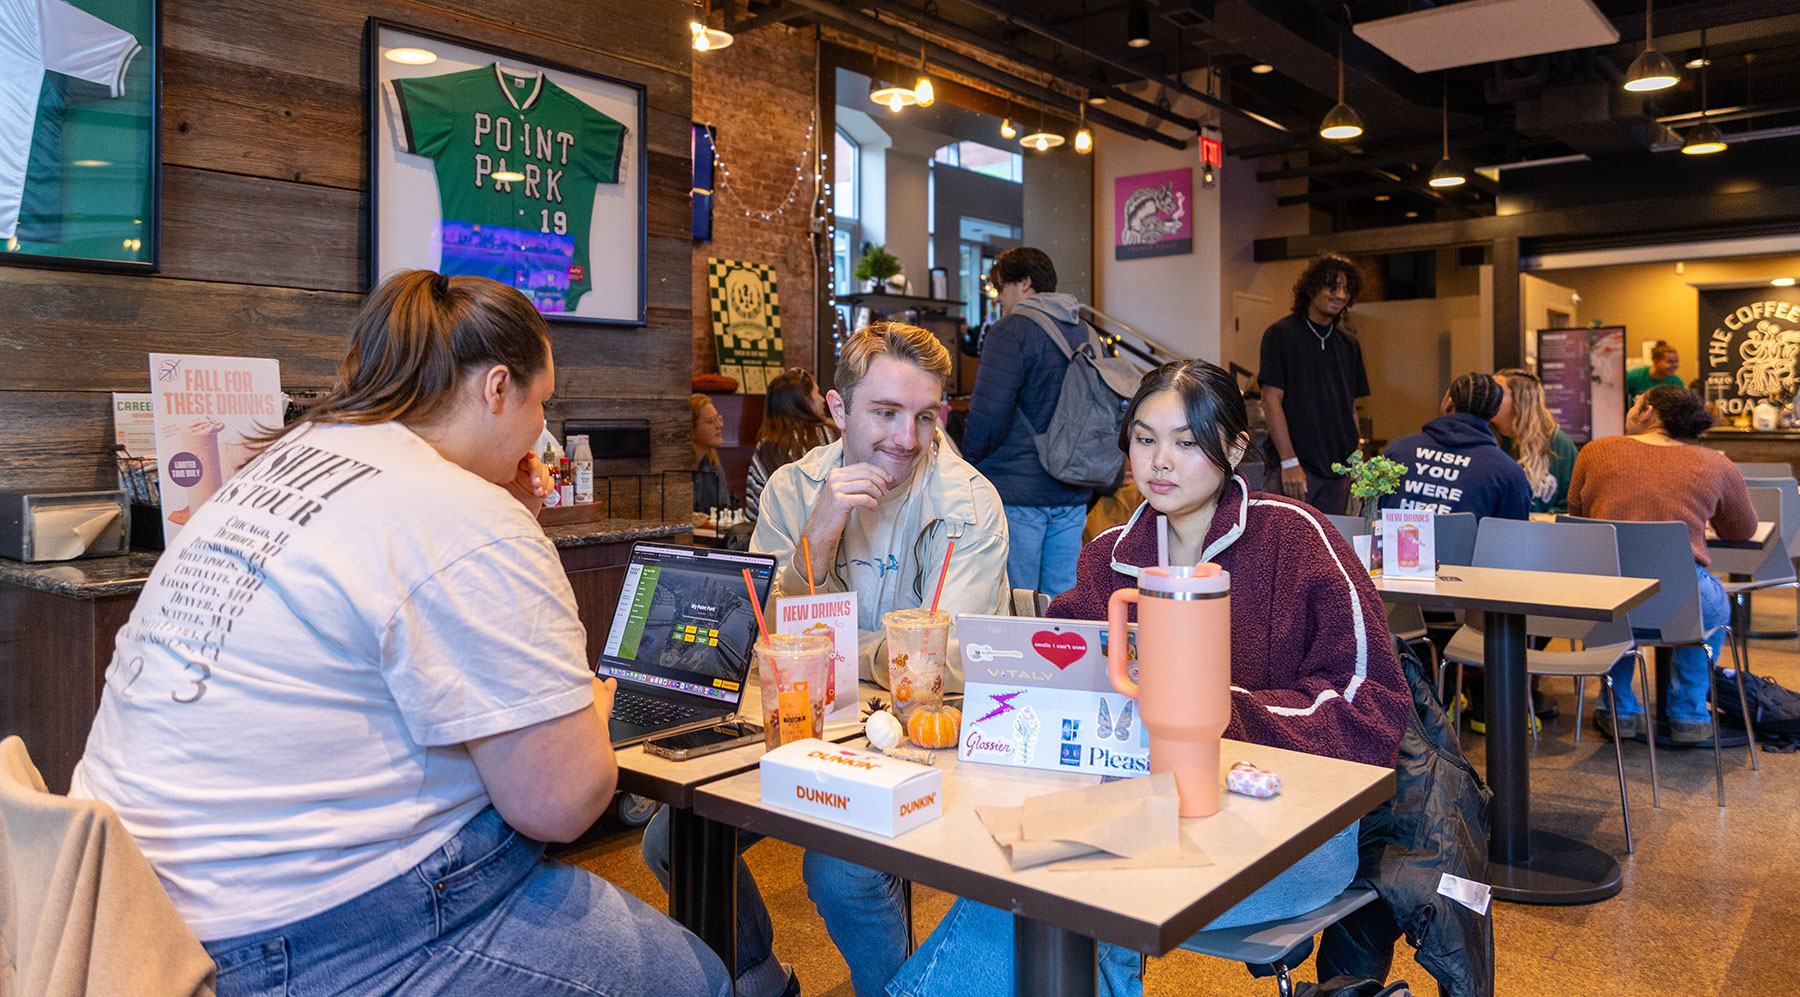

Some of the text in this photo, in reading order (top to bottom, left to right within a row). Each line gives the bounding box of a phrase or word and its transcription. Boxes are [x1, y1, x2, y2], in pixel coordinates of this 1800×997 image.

[474, 111, 575, 166] POINT
[474, 153, 563, 203] PARK
[540, 208, 568, 236] 19
[1708, 300, 1800, 368] THE COFFEE
[184, 369, 253, 393] FALL FOR
[116, 401, 152, 411] CAREE
[163, 392, 275, 416] THESE DRINKS
[1415, 446, 1472, 468] WISH
[252, 443, 384, 501] SWIFT
[1414, 462, 1460, 482] YOU
[1404, 479, 1463, 502] WERE
[238, 484, 322, 527] TOUR
[1386, 513, 1430, 523] NEW DRINKS
[783, 600, 851, 623] NEW DRINKS
[987, 668, 1054, 681] VITALY
[807, 750, 883, 770] DUNKIN'
[796, 785, 850, 810] DUNKIN'
[900, 791, 937, 816] DUNKIN'
